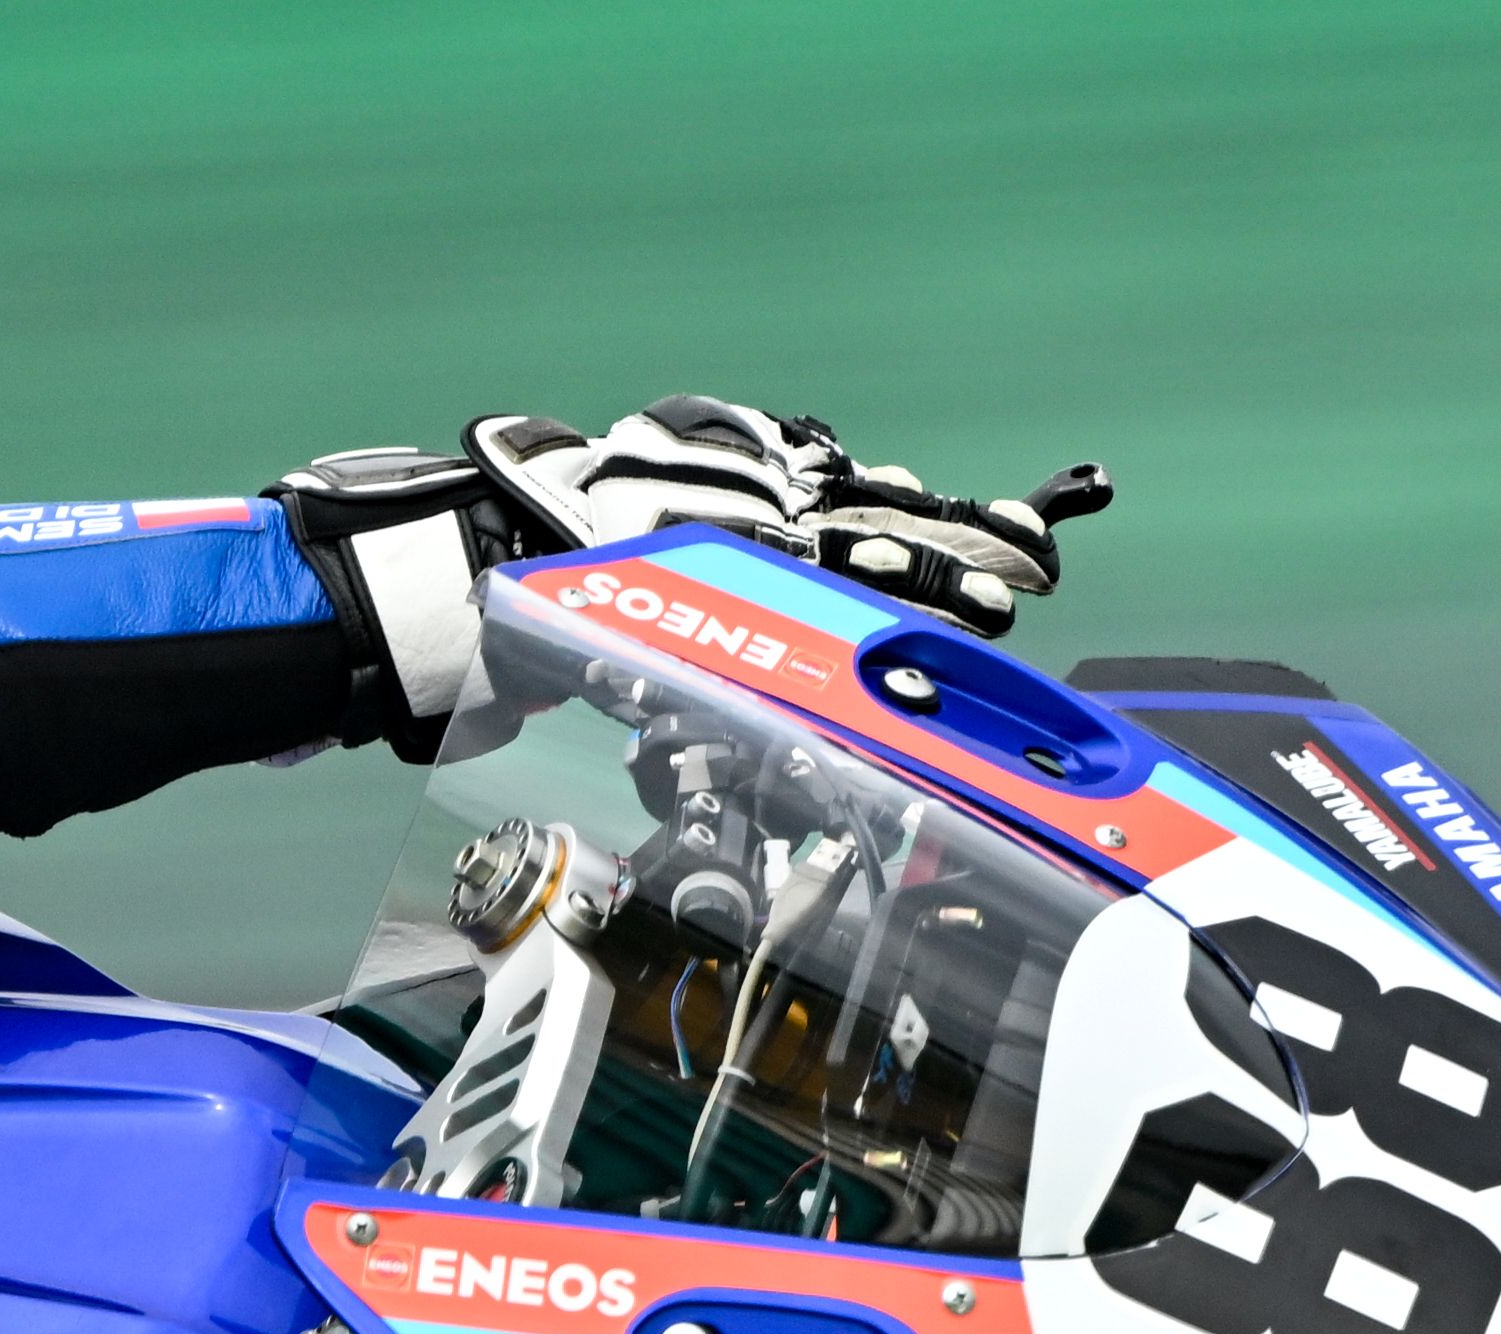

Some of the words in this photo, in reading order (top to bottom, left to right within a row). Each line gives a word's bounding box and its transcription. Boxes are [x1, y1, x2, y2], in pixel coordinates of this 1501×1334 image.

[584, 572, 787, 671] ENEOS
[1284, 748, 1415, 873] YAMALUBE
[415, 1247, 636, 1318] ENEOS
